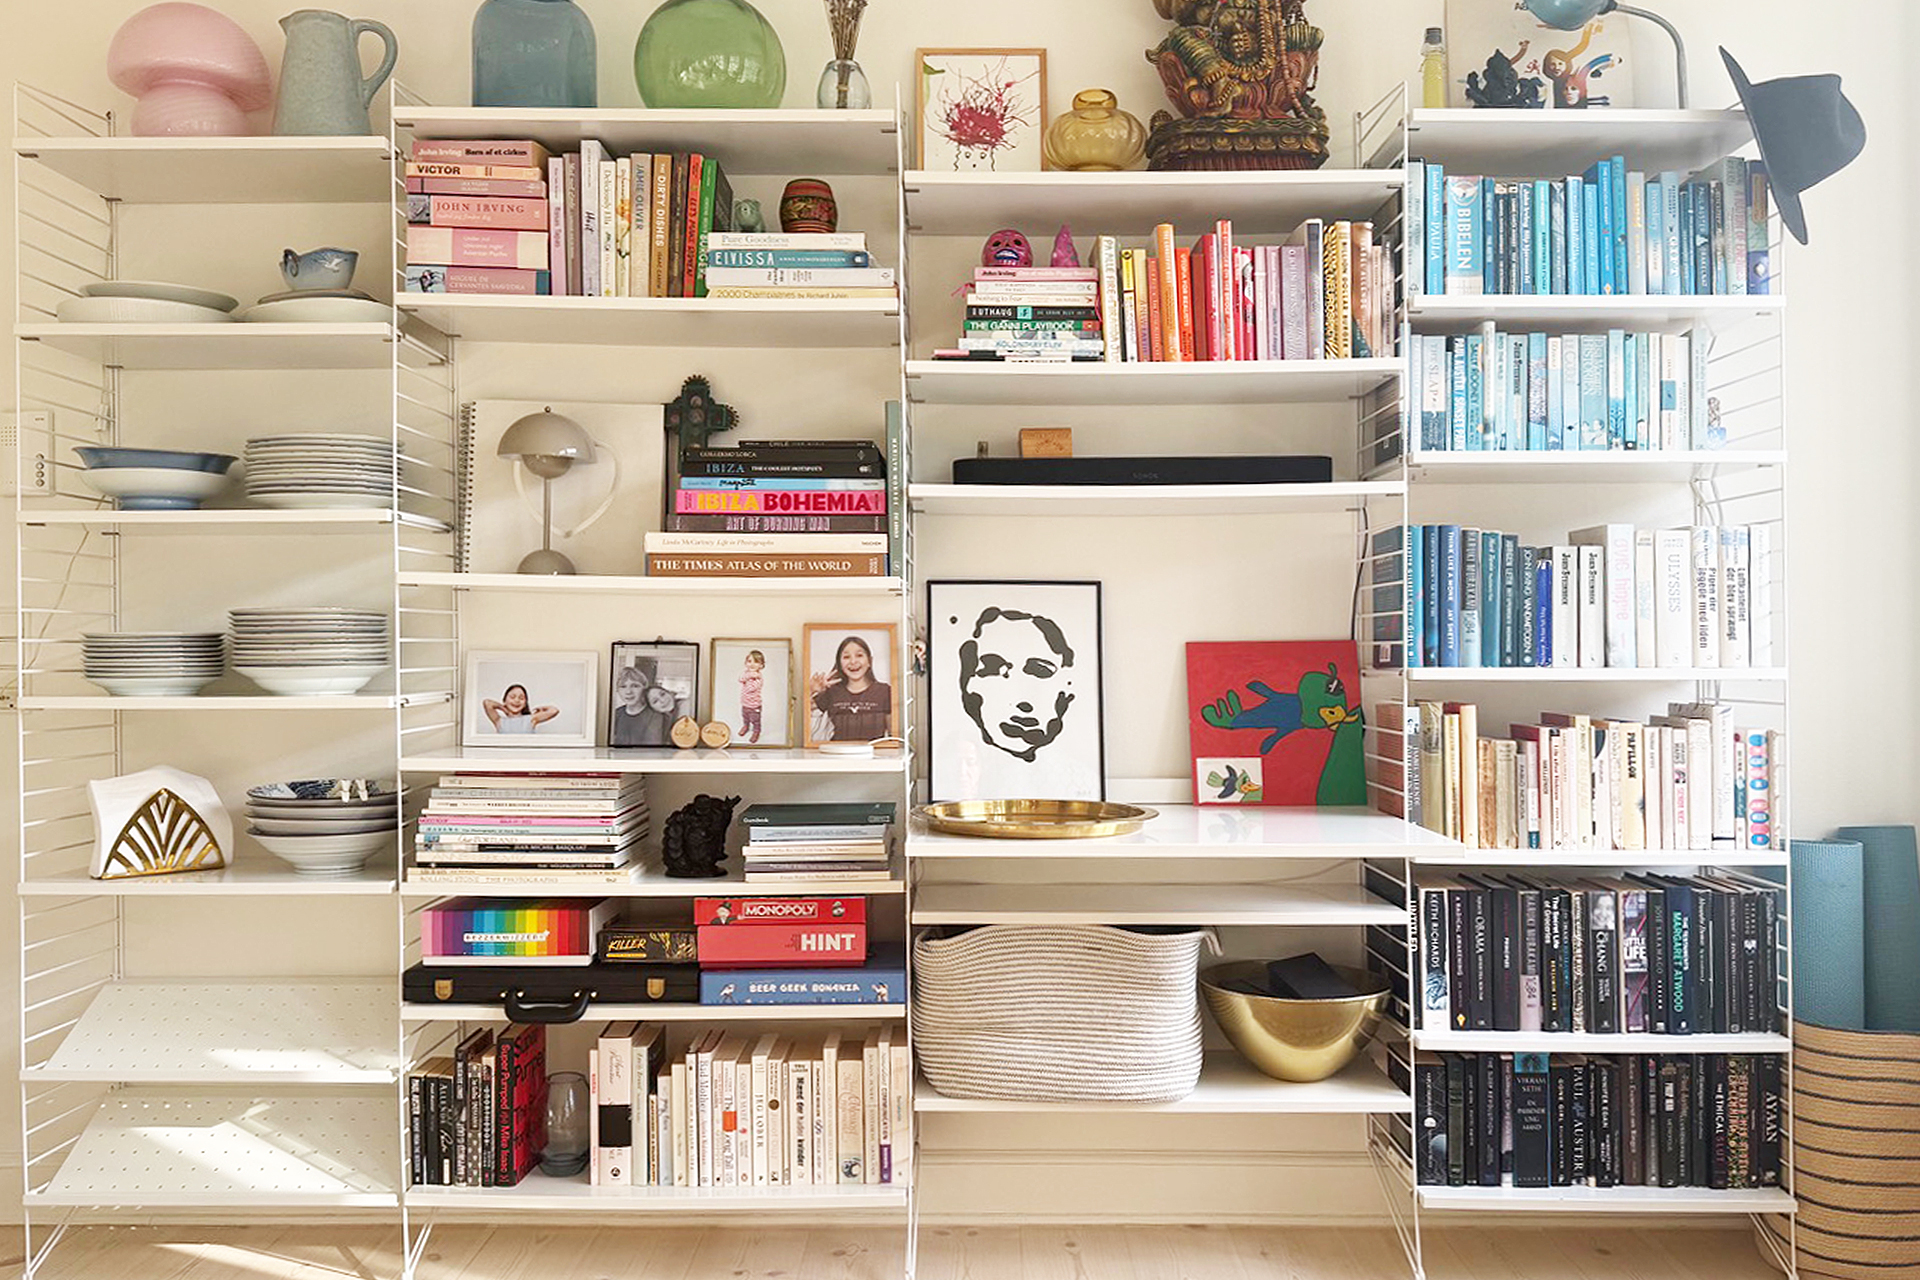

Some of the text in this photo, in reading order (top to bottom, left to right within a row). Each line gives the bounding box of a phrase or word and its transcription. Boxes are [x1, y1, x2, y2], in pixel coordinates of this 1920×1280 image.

[417, 165, 460, 175] VICTOR
[436, 202, 470, 213] JOHN
[656, 175, 667, 207] DIRTY
[635, 195, 645, 230] OLIVER
[656, 209, 667, 247] DISHES
[1431, 222, 1440, 260] PAULA
[1457, 208, 1471, 269] BIBELEN
[715, 252, 775, 266] EIVISSA
[697, 493, 872, 511] IBIZA BOHEMIA
[653, 560, 852, 571] THE TIMES ATLAS OF THE WORLD
[1668, 554, 1681, 613] ULYSSES
[746, 903, 815, 916] MONOPOLY
[608, 938, 647, 951] KILLER
[801, 934, 855, 950] HINT
[1430, 922, 1440, 968] RICHARDS
[1475, 916, 1485, 954] OBAMA
[1596, 931, 1606, 972] CHANG
[1673, 911, 1683, 1012] MARGARET ATWOOD
[750, 982, 860, 992] BEER GEEK BONANZA
[500, 1044, 512, 1172] Super Pumped Mike Isaac
[1574, 1066, 1584, 1171] PAUL AUSTER
[1715, 1094, 1724, 1134] ETHICAL
[1766, 1092, 1777, 1142] AYAAN
[797, 1139, 805, 1167] kvinder
